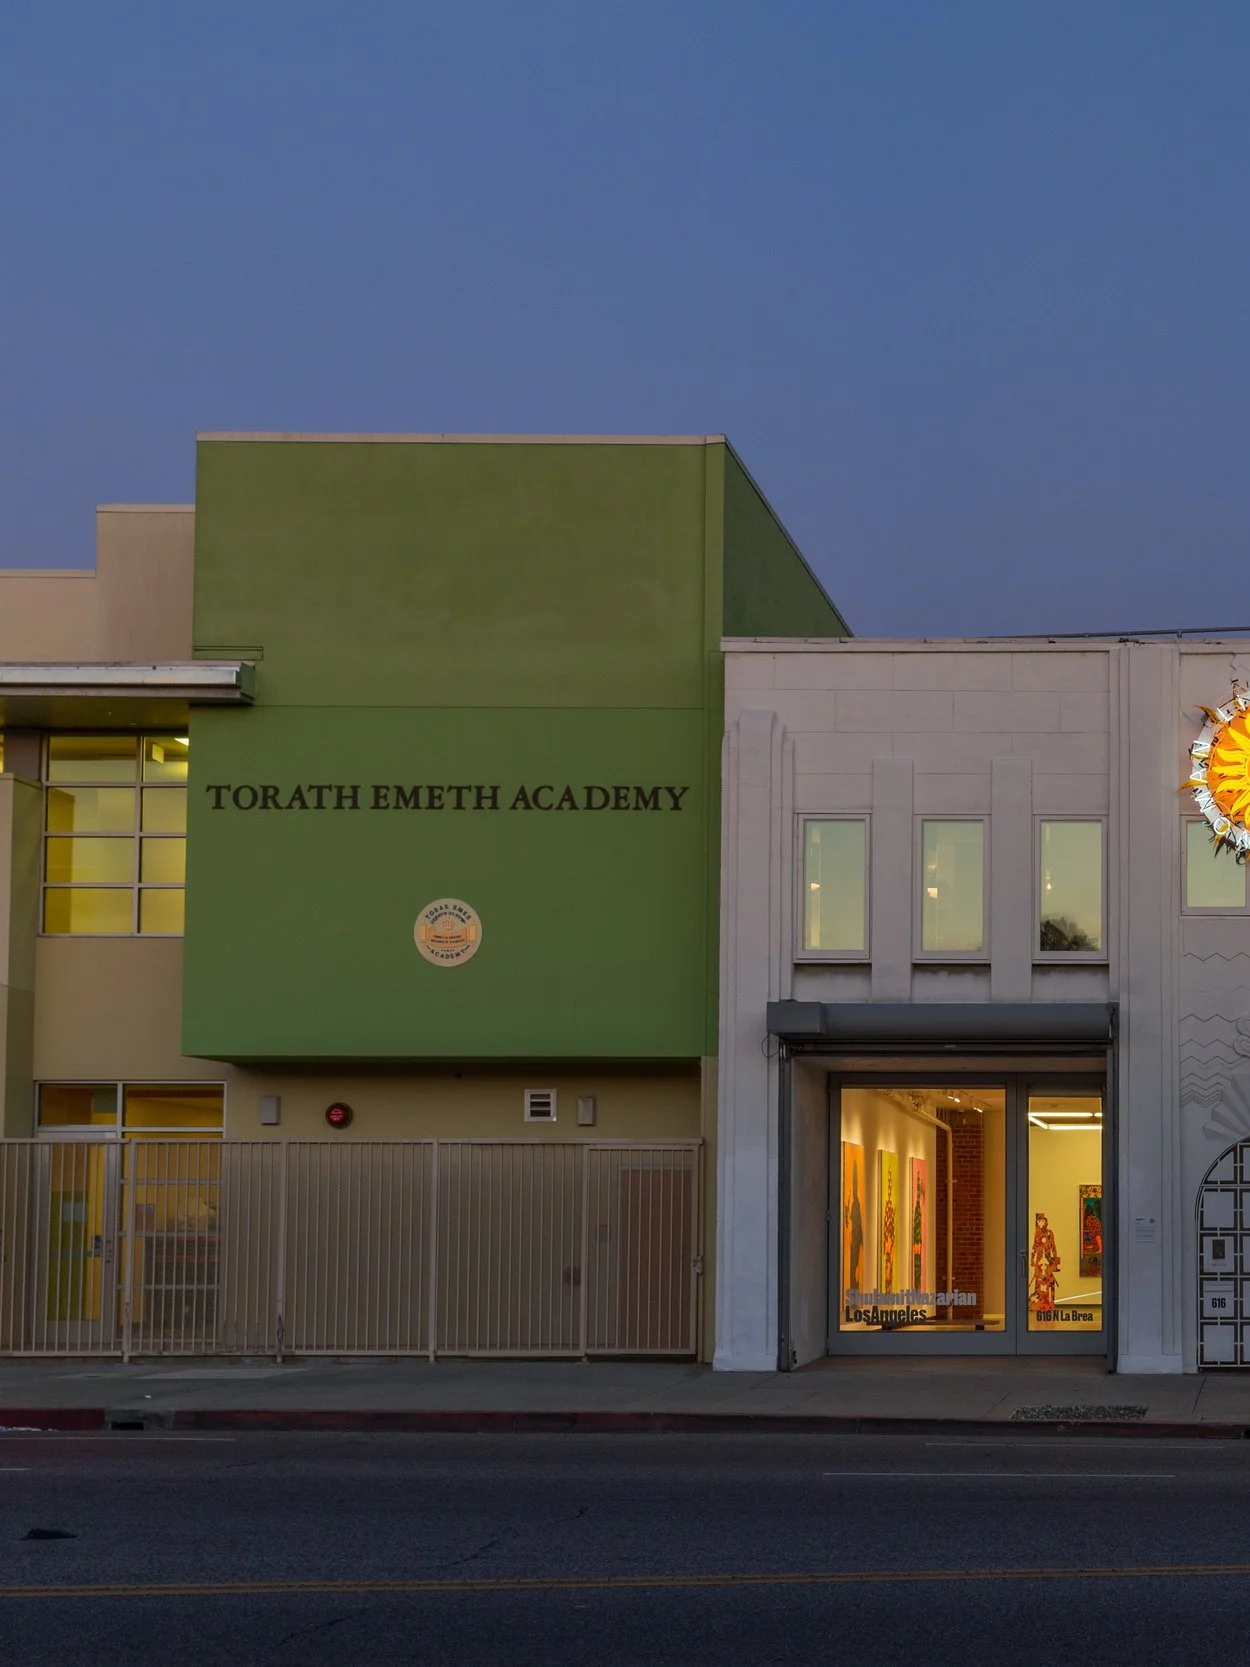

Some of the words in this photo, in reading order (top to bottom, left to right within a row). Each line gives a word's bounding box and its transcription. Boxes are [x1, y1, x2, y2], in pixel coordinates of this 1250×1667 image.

[206, 784, 360, 811] TORATH
[370, 784, 500, 811] EMETH
[509, 784, 690, 812] ACADEMY
[431, 949, 466, 960] ACADEMY
[1211, 1297, 1227, 1308] 616
[1036, 1310, 1052, 1321] 616
[1053, 1310, 1059, 1321] N
[1060, 1310, 1071, 1321] La
[1071, 1310, 1093, 1321] Brea
